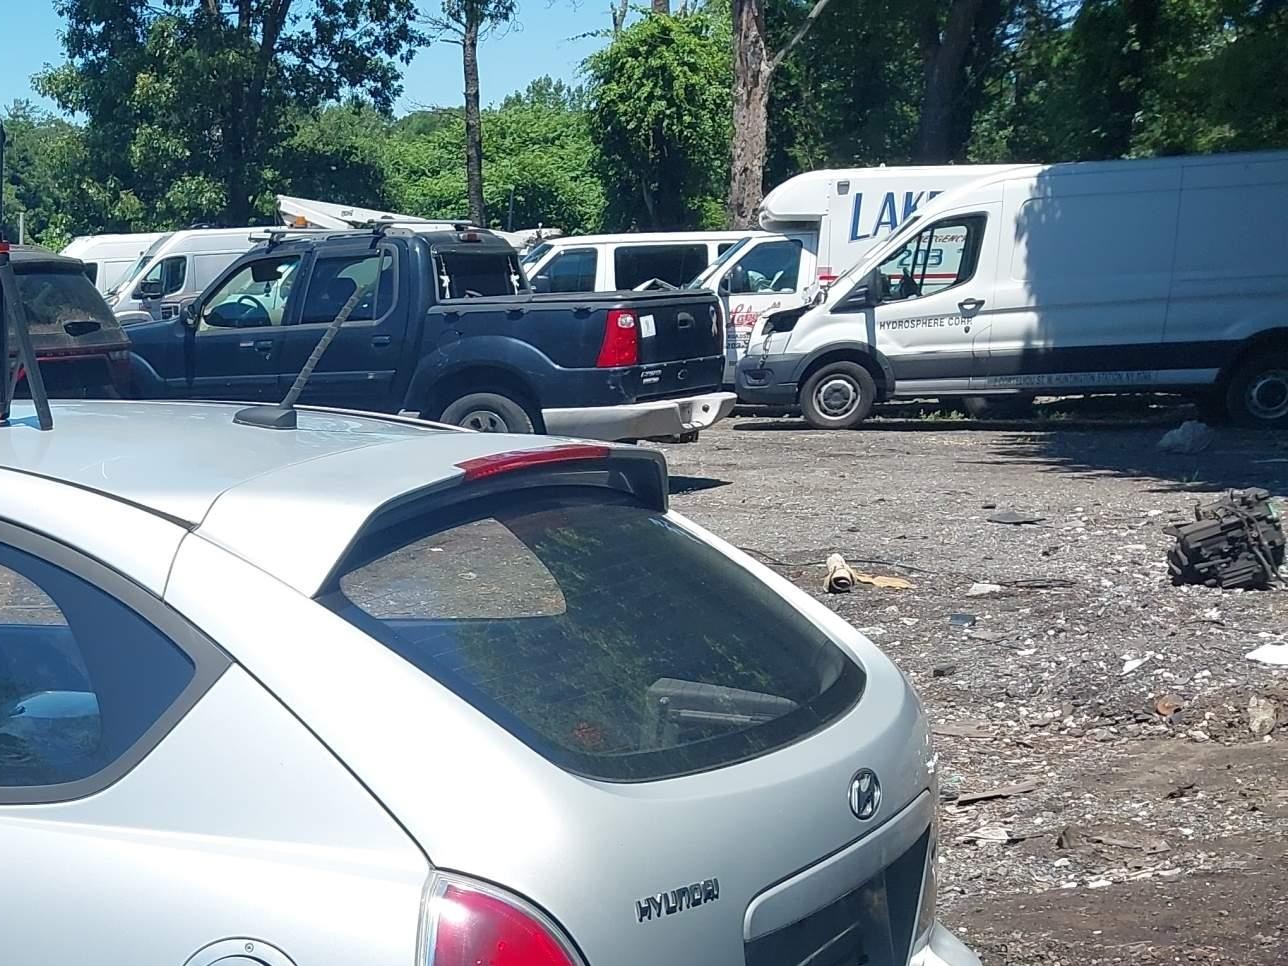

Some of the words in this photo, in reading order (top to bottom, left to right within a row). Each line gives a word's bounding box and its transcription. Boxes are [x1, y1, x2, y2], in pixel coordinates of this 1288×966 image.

[848, 190, 944, 243] LAK
[879, 317, 945, 330] HYDROSPHERE
[634, 876, 720, 923] HYUNDAI
